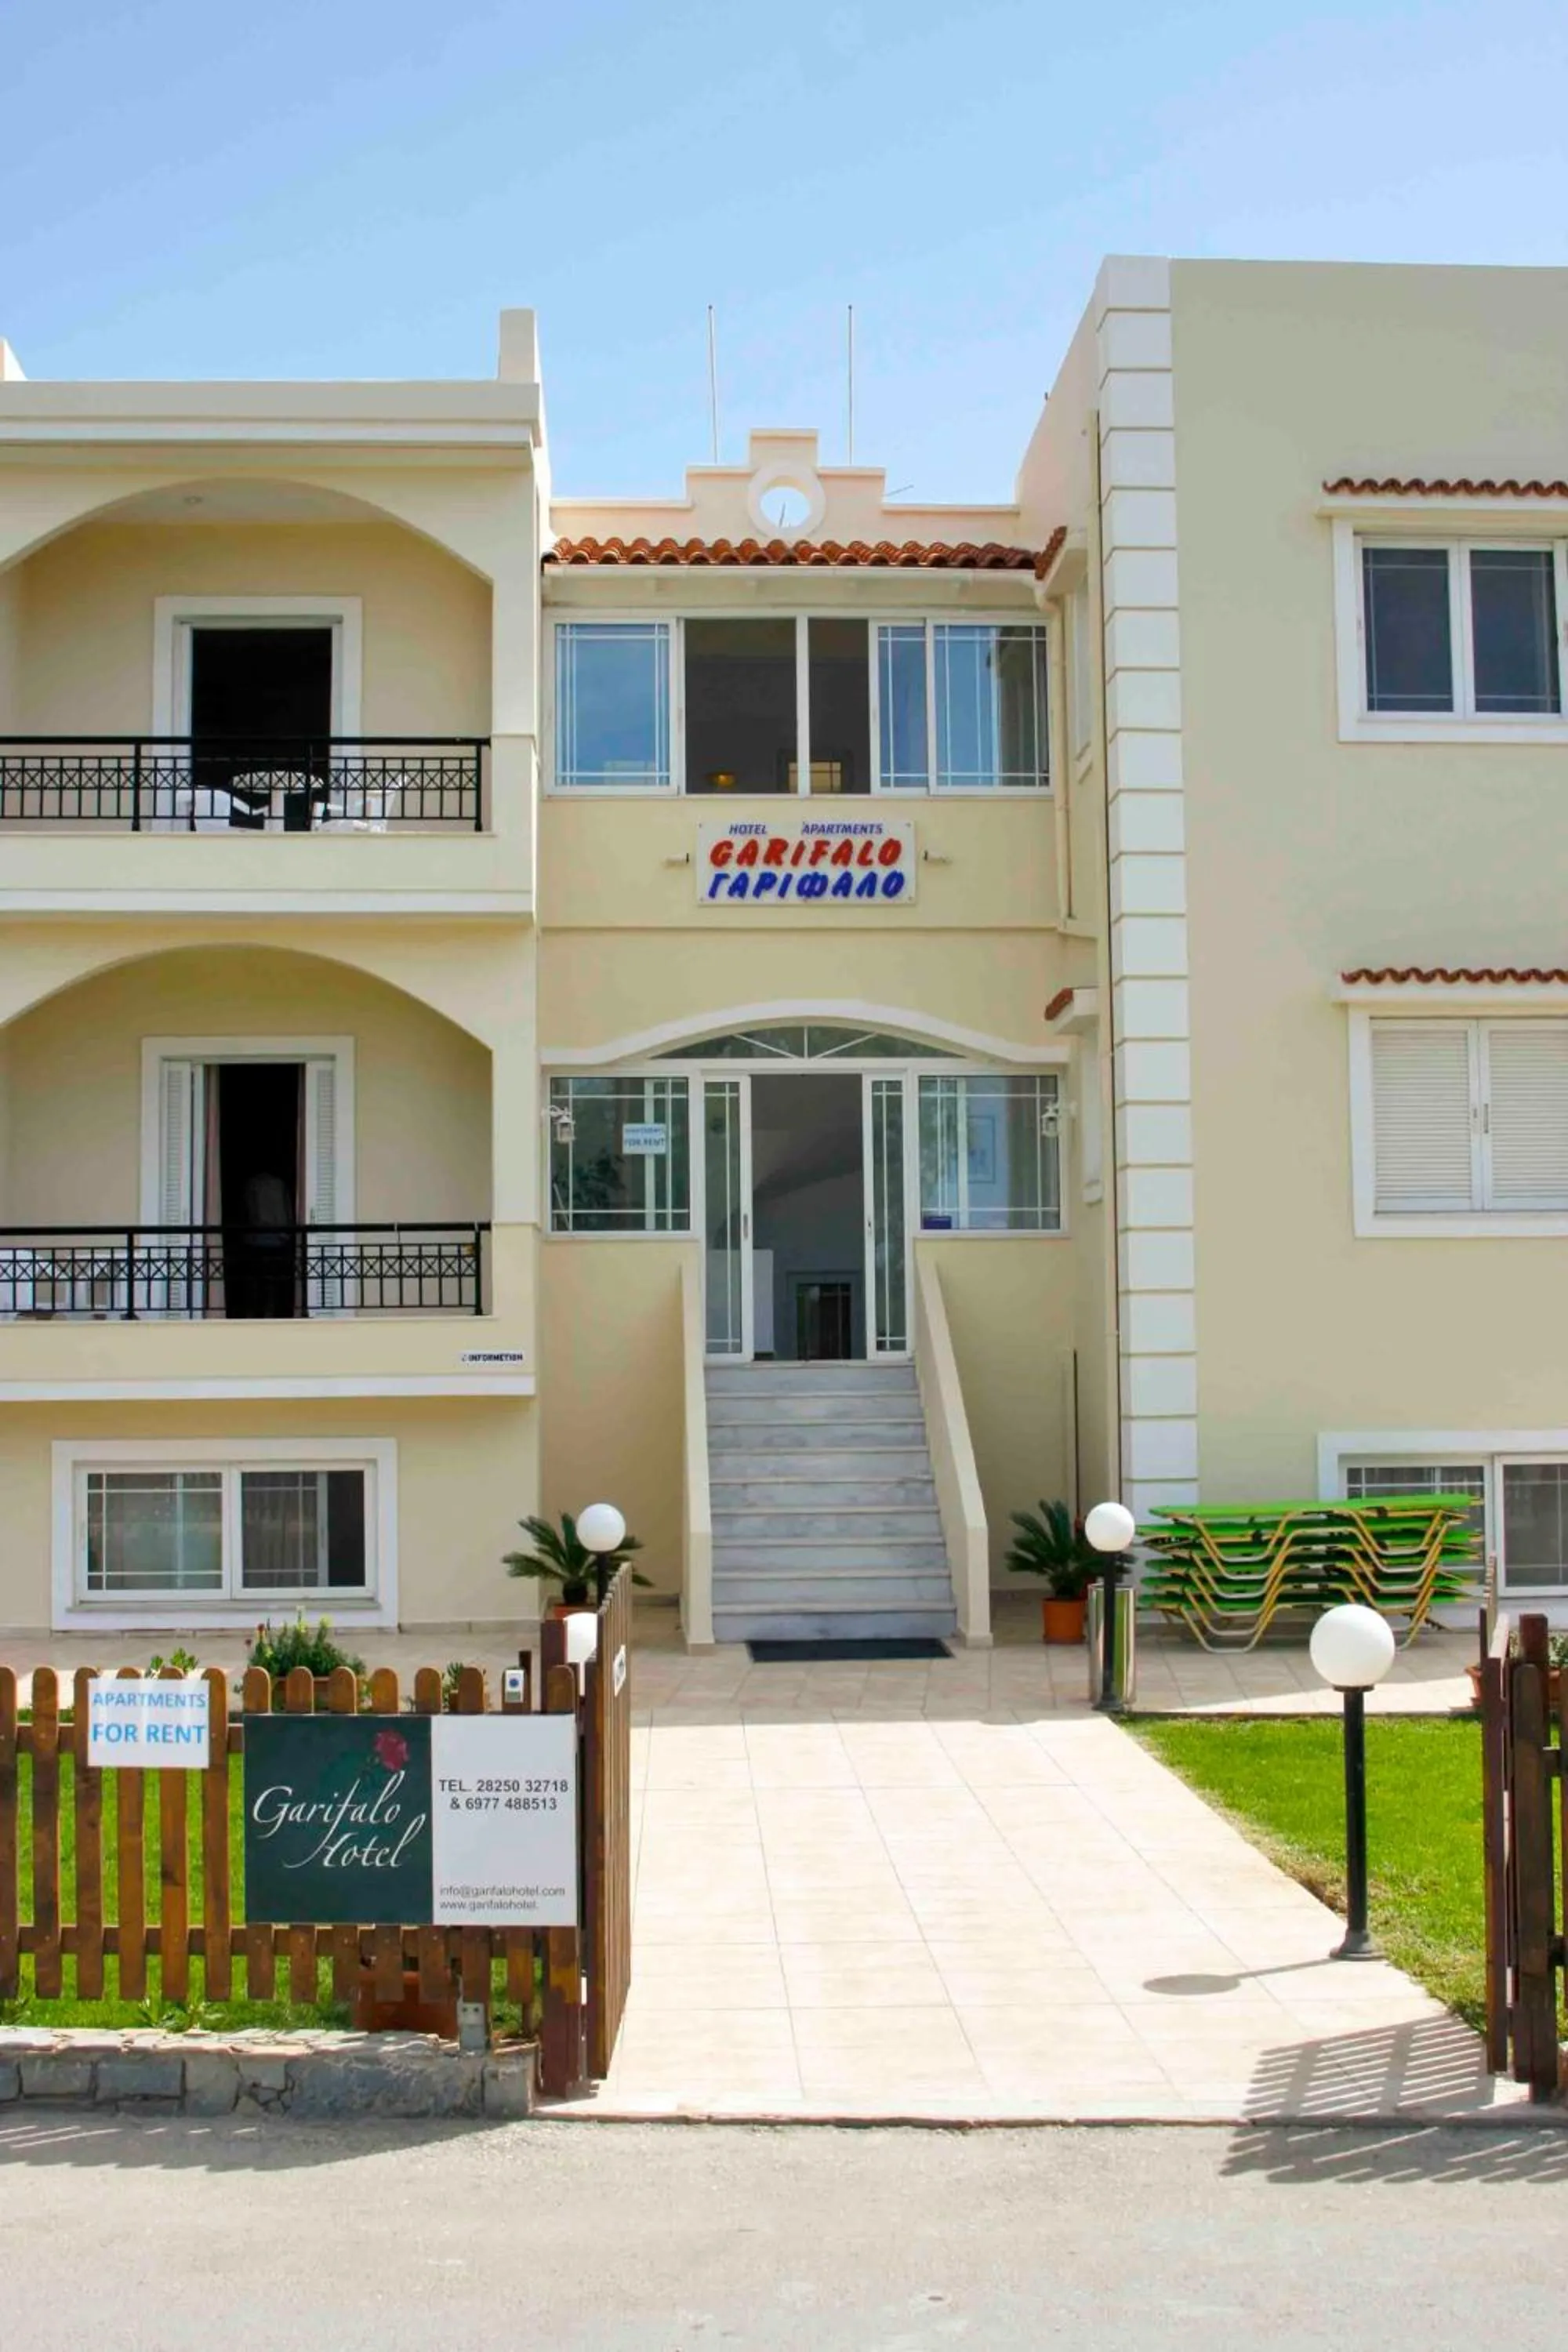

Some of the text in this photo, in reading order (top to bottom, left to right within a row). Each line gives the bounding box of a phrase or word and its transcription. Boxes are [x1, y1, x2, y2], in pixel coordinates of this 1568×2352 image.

[728, 822, 884, 835] HOTEL APARTMENTS
[709, 837, 902, 868] GARIFALO
[707, 870, 906, 899] ΓΑΡΙΦΑΛΟ
[93, 1692, 206, 1708] APARTMENTS
[93, 1722, 207, 1744] FOR RENT
[438, 1779, 569, 1792] TEL. 28250 32718
[449, 1797, 557, 1810] & 6977 488513
[252, 1769, 406, 1868] Garifalo
[321, 1813, 426, 1868] Hotel
